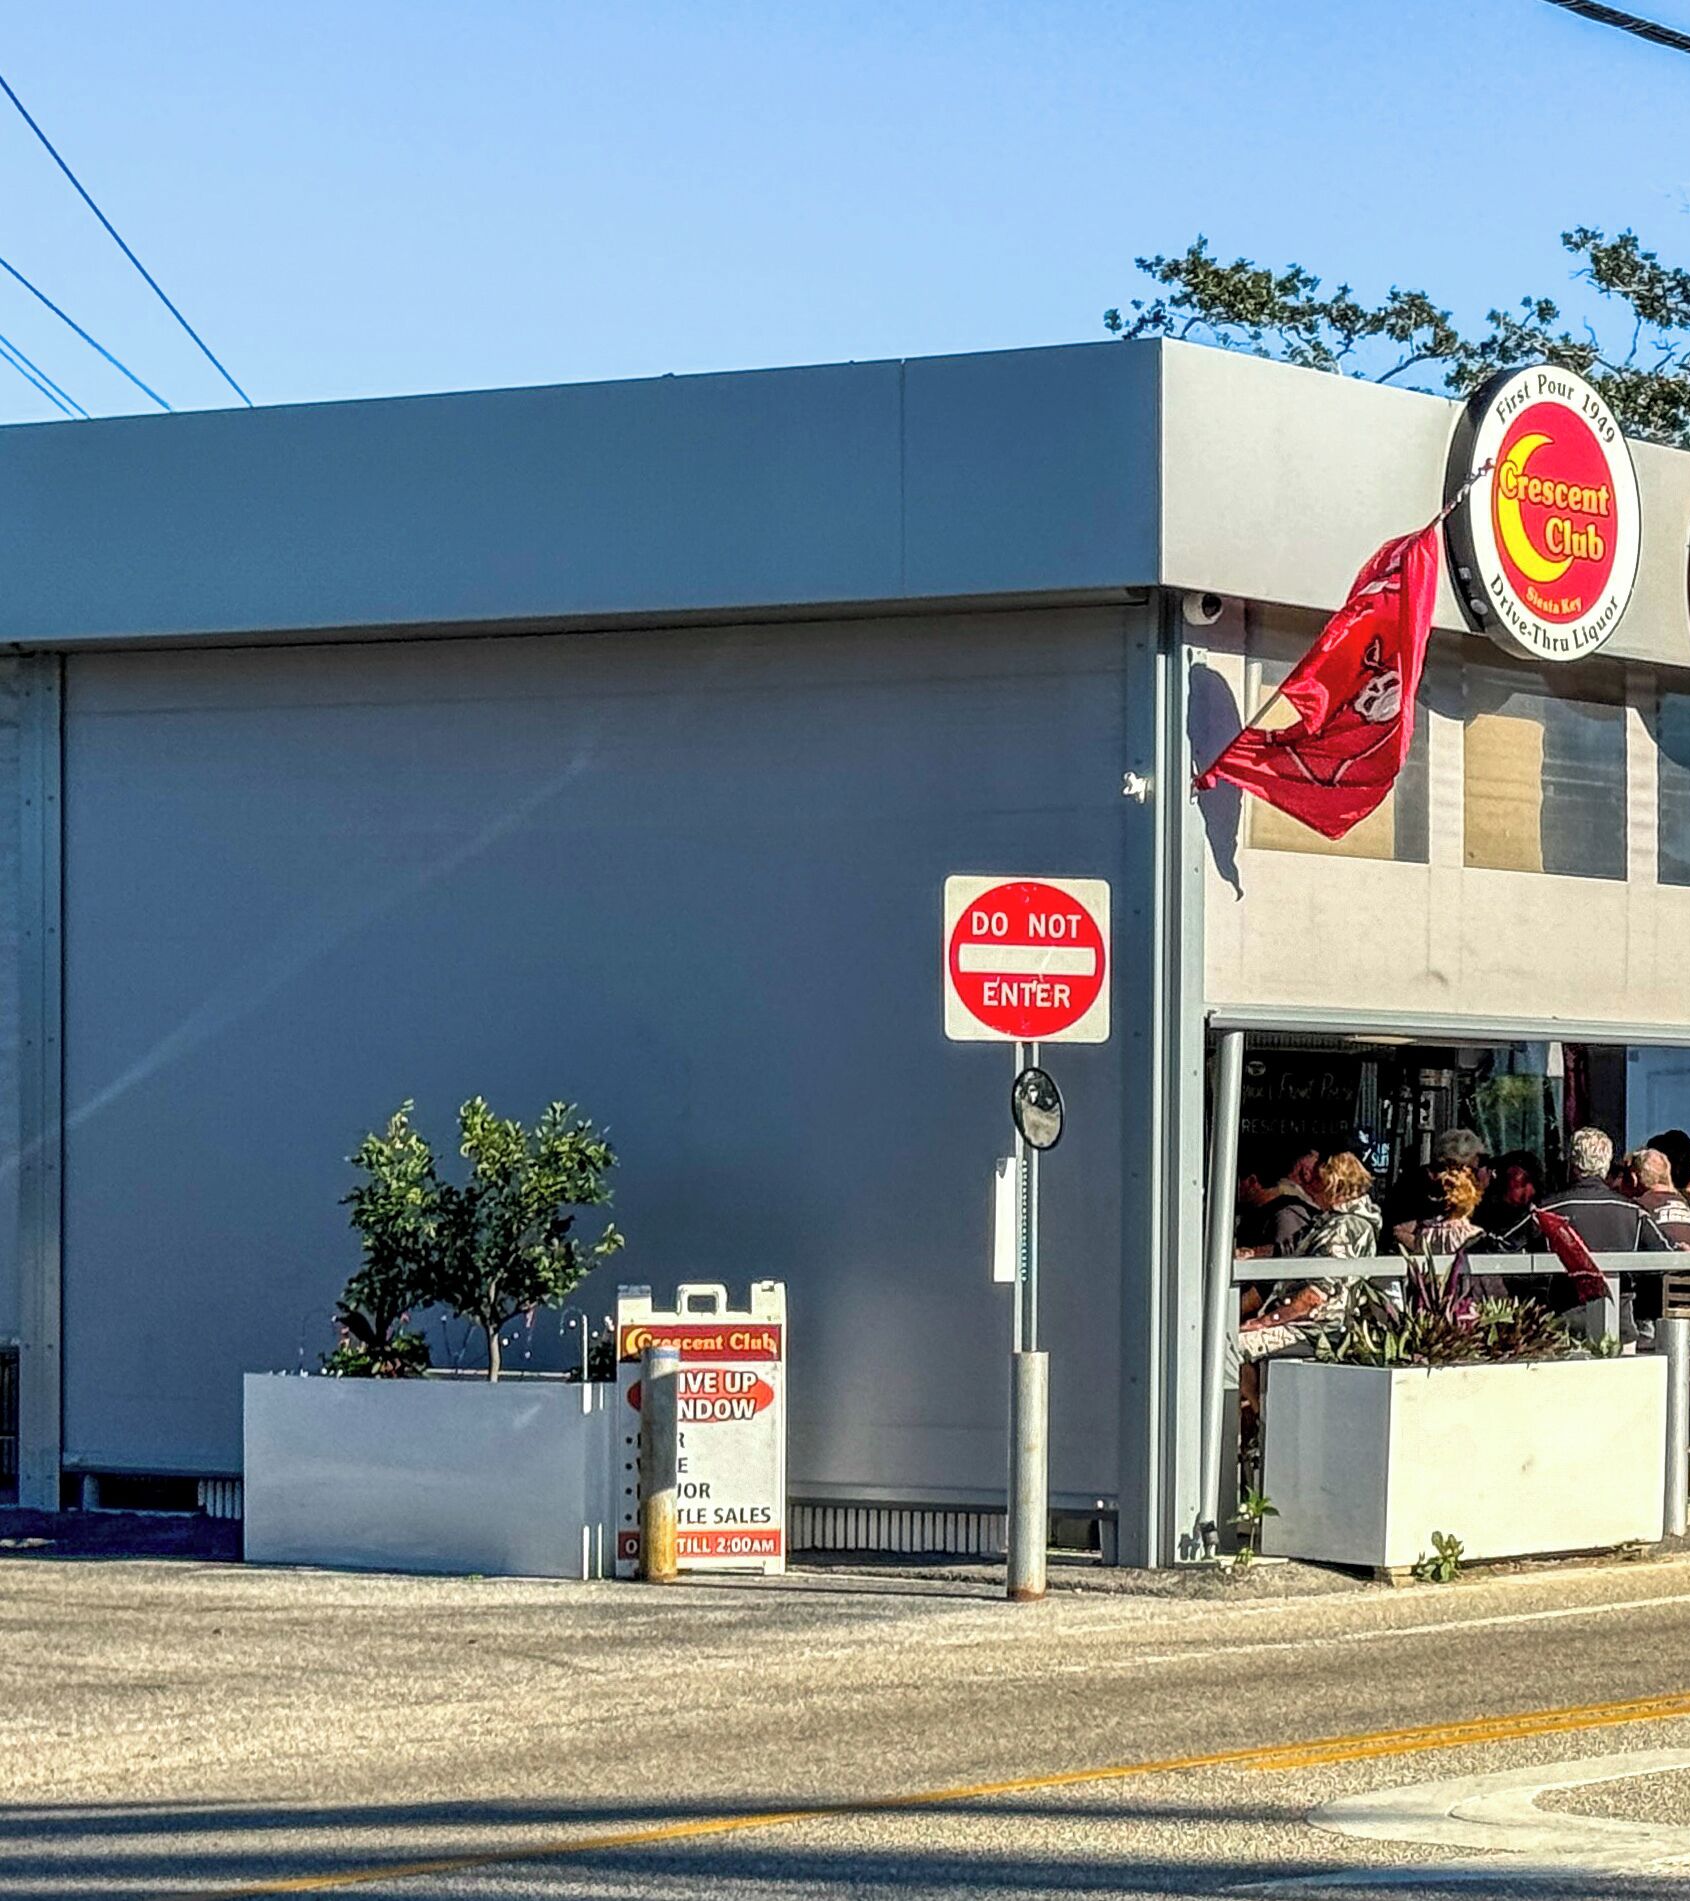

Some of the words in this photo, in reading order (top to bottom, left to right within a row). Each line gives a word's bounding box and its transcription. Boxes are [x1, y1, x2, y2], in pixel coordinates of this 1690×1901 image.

[1496, 381, 1532, 424] First
[1537, 374, 1575, 400] Pour
[1581, 393, 1616, 444] 1949
[1499, 460, 1611, 516] Crescent
[1545, 518, 1605, 561] Club
[1490, 574, 1570, 652] Drive-Thru
[1573, 595, 1618, 650] Liquor
[1561, 596, 1582, 615] Key
[971, 911, 1009, 937] DO
[1028, 913, 1082, 939] NOT
[982, 981, 1071, 1009] ENTER
[729, 1332, 778, 1352] Club
[678, 1371, 721, 1394] IVE
[724, 1371, 759, 1394] UP
[677, 1398, 756, 1420] NDOW
[713, 1507, 772, 1524] SALES
[716, 1536, 775, 1553] 2:00AM
